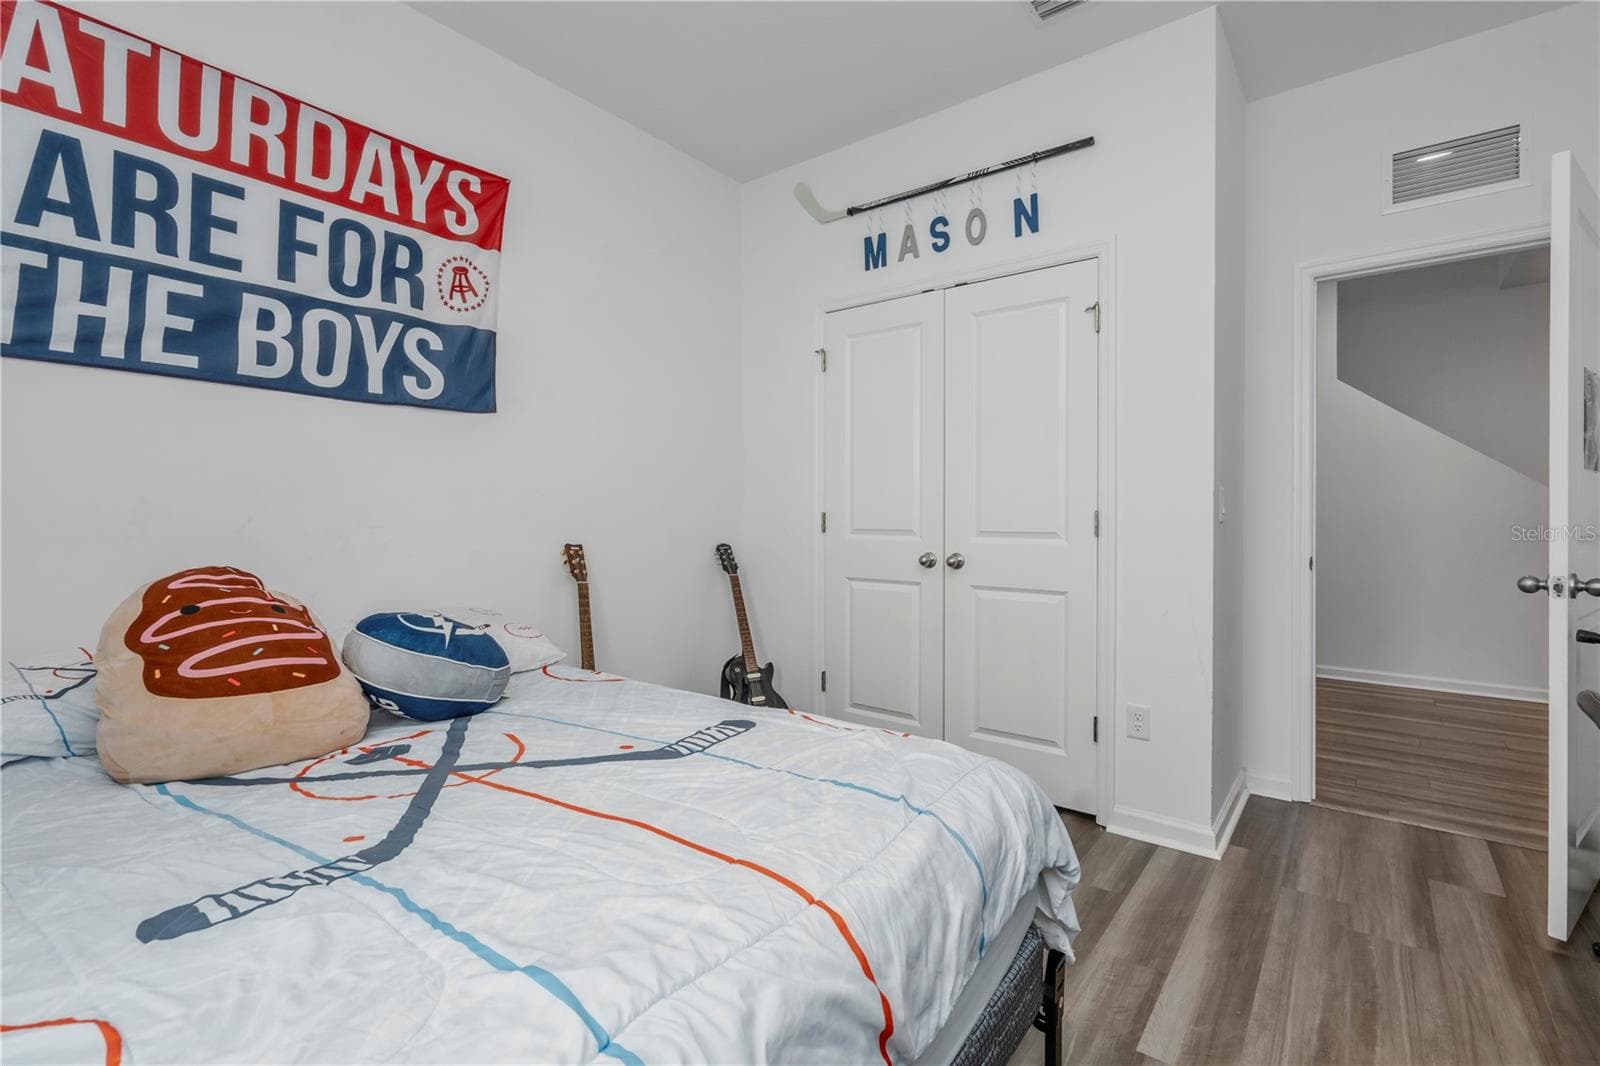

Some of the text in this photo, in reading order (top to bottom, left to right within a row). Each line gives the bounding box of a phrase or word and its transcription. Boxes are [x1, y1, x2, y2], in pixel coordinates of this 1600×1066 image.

[14, 129, 425, 311] ARE FOR
[864, 193, 1039, 271] MASON
[0, 244, 444, 400] THE BOYS
